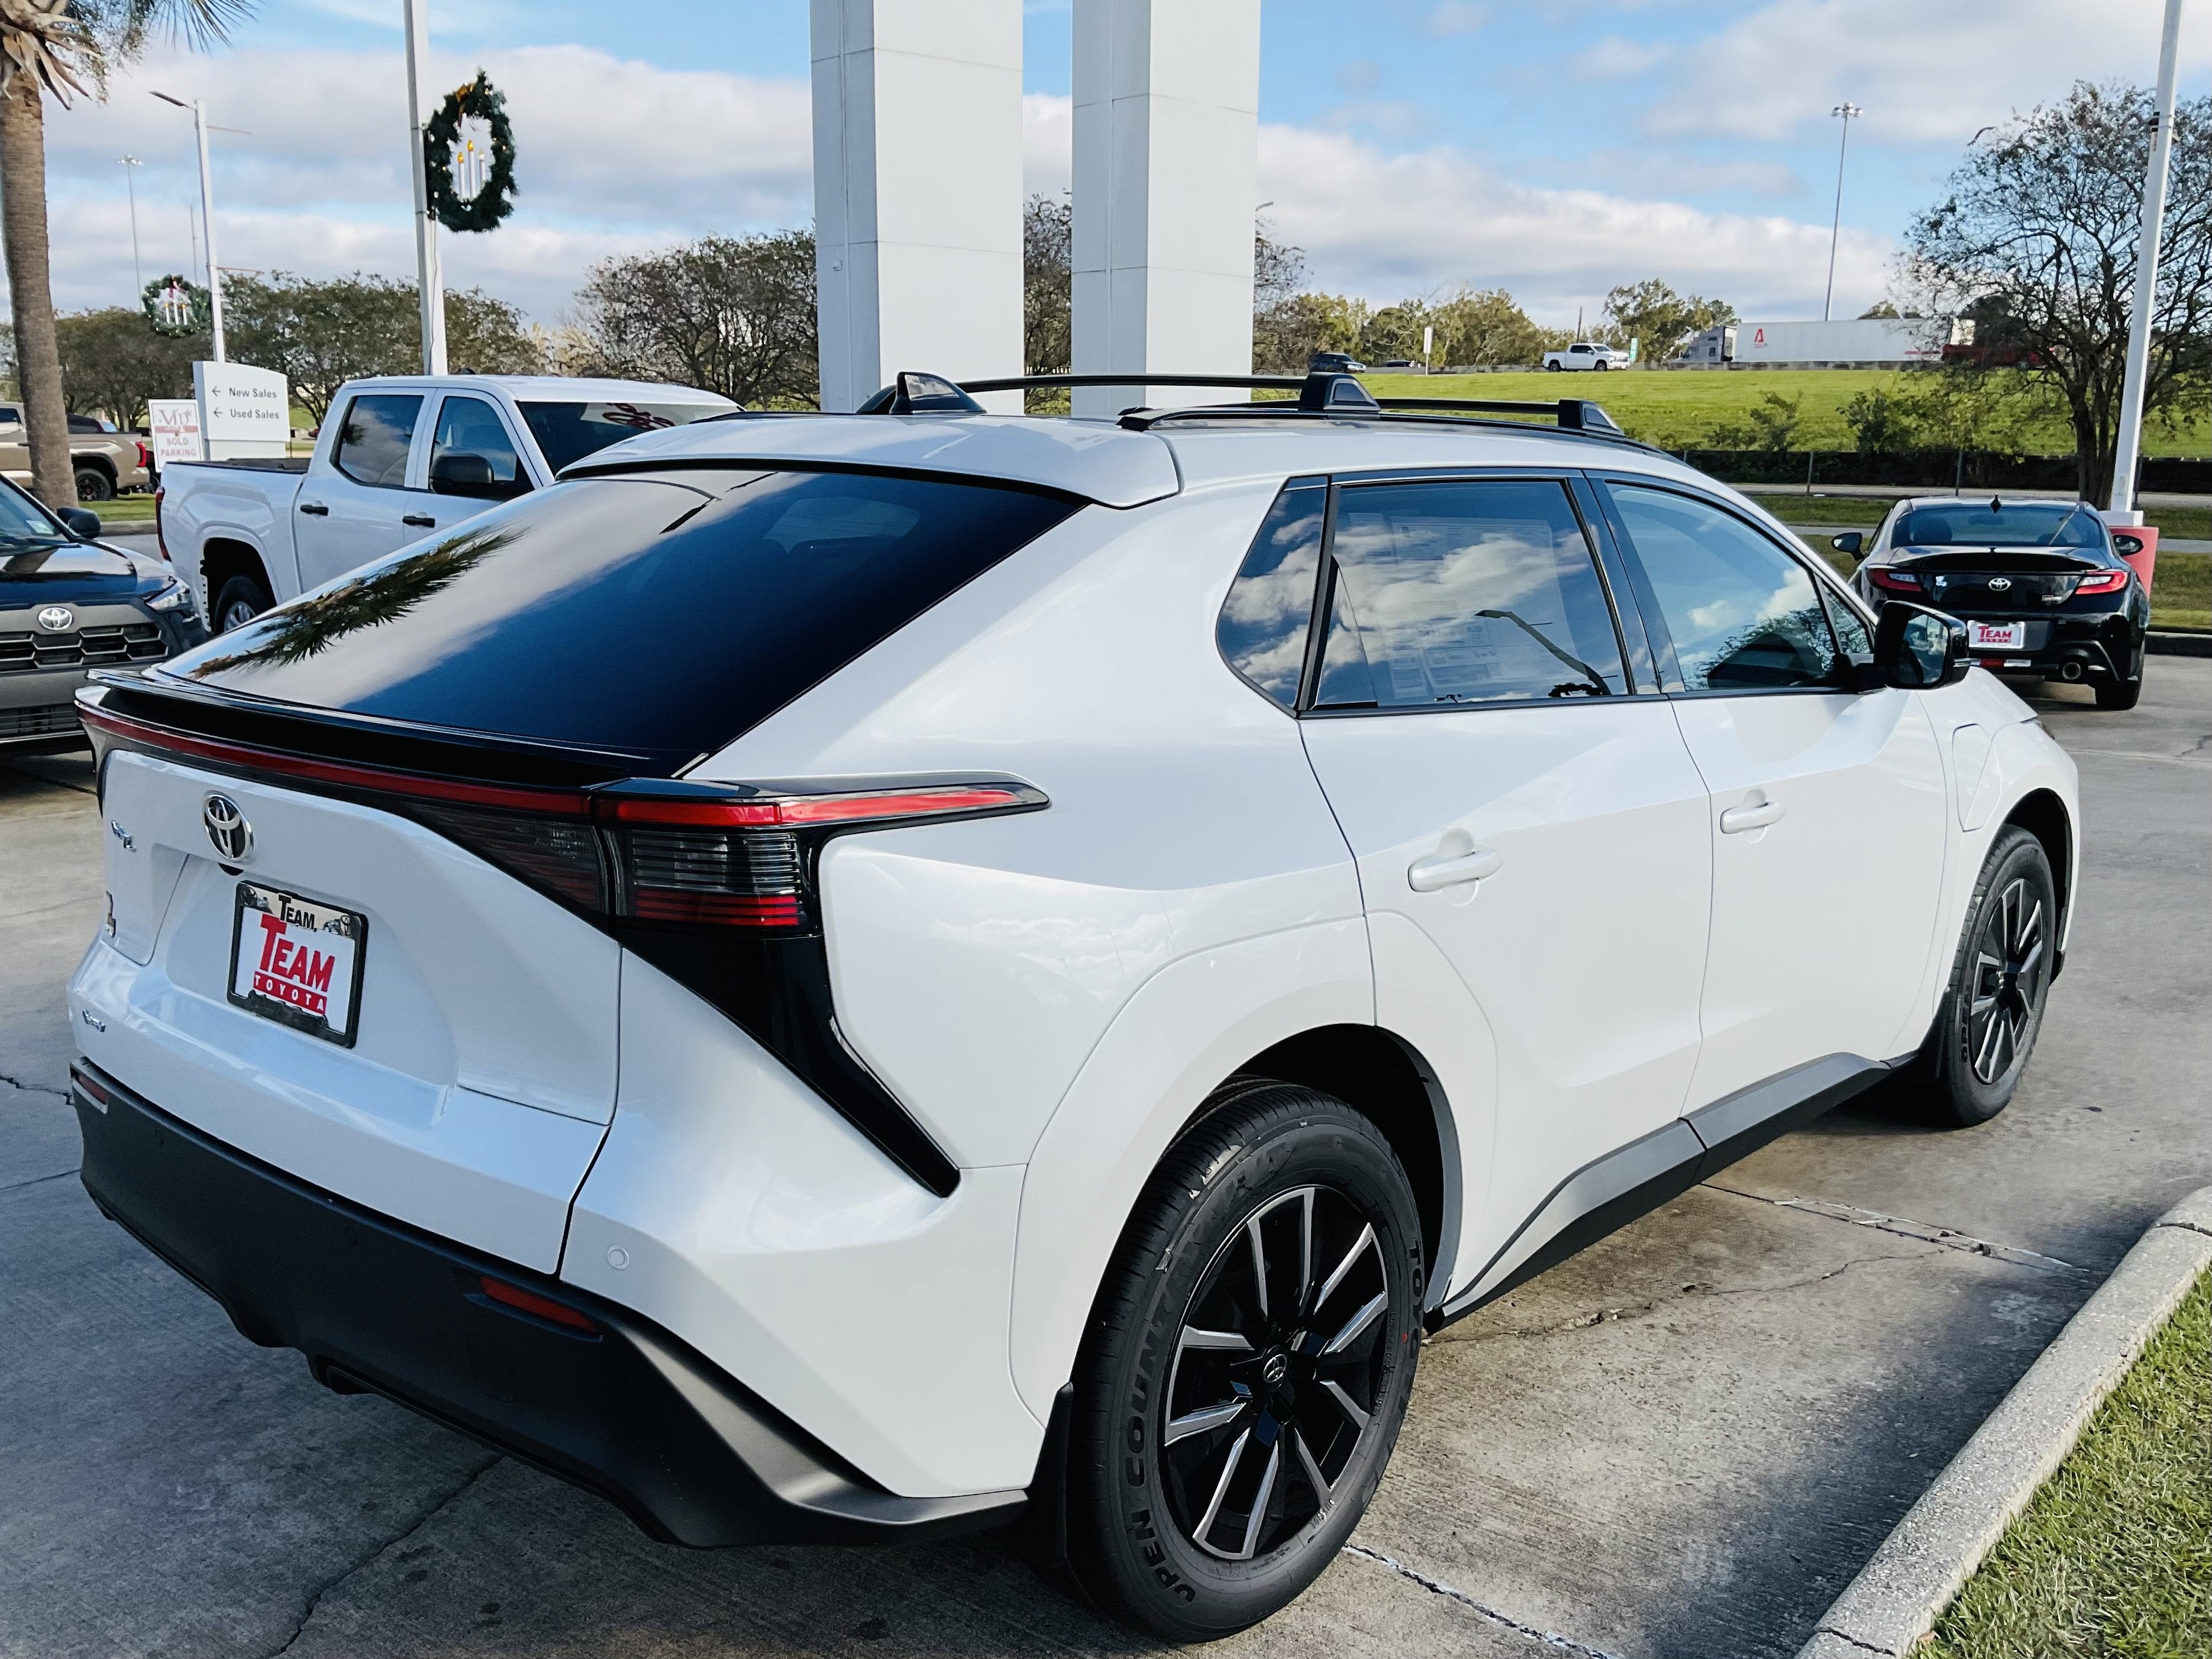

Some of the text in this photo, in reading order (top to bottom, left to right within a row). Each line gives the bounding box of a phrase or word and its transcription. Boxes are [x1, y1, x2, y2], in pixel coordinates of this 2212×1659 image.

[229, 388, 277, 398] New Sales
[230, 408, 279, 419] Used Sales
[166, 437, 189, 446] SOLD
[160, 448, 196, 457] PARKING
[1978, 625, 2012, 638] TEAM
[259, 912, 335, 992] TEAM
[254, 974, 324, 1011] TOYOTA
[1131, 1509, 1197, 1608] OPEN
